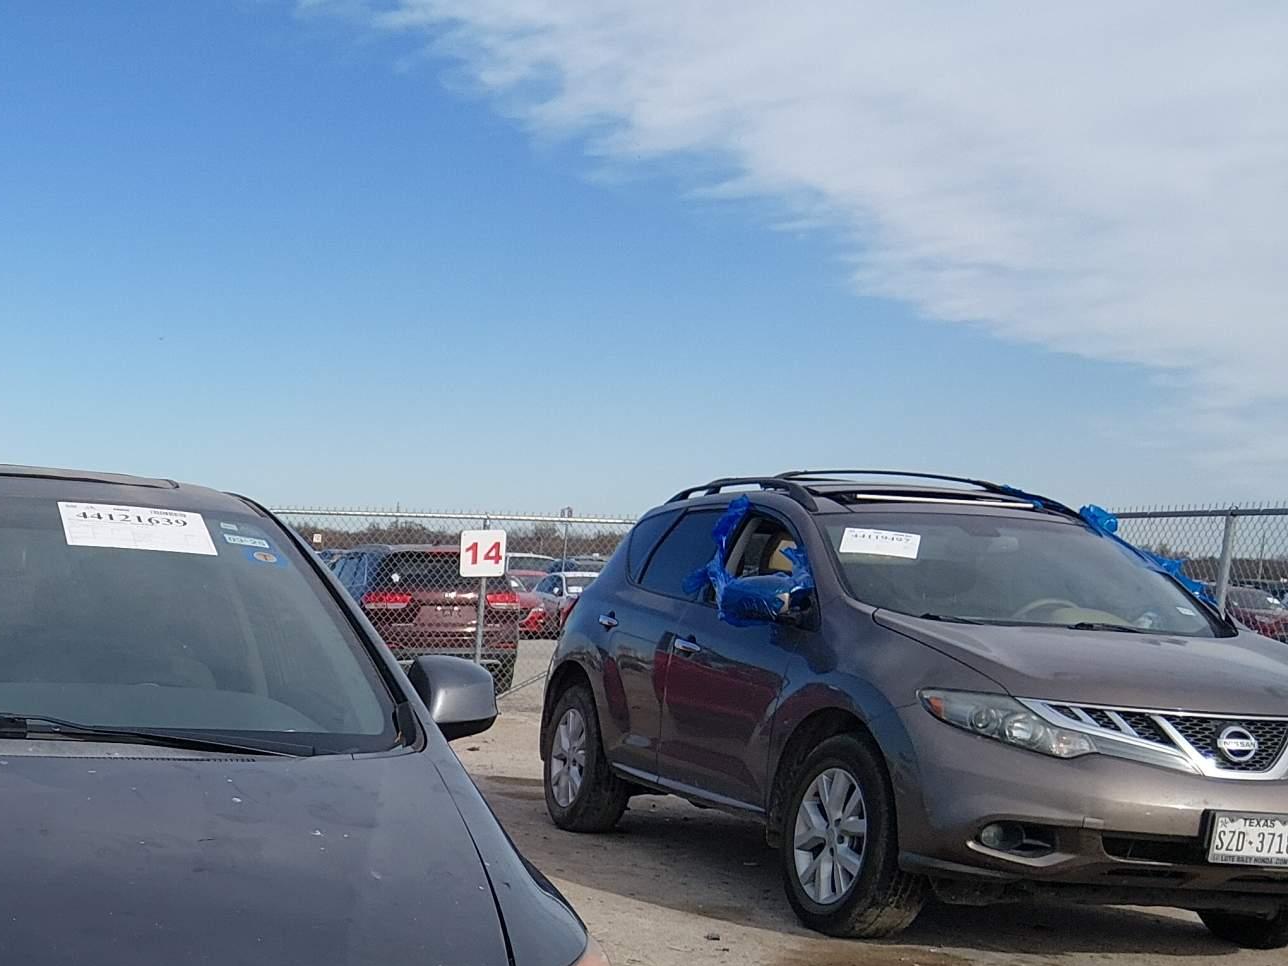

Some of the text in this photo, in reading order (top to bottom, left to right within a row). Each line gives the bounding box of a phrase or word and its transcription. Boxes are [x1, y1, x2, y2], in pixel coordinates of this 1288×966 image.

[75, 511, 188, 527] 44121639
[465, 541, 503, 565] 14
[1223, 740, 1256, 748] NISSAN
[1242, 817, 1275, 828] TEXAS
